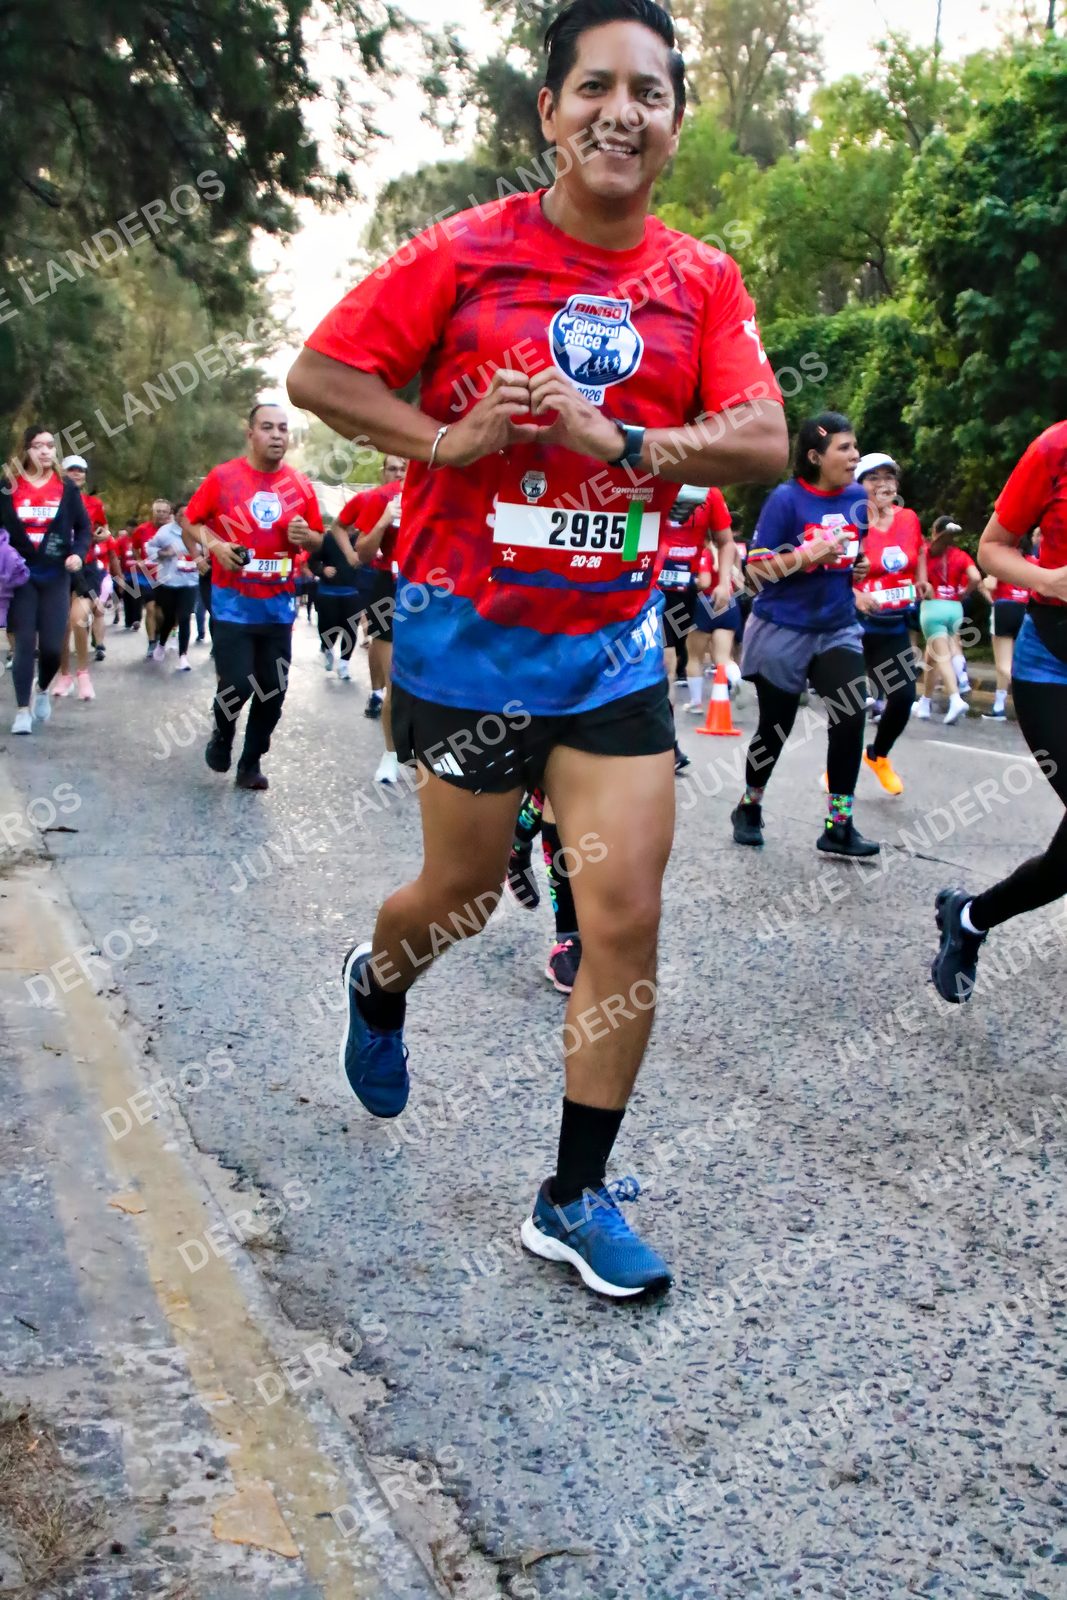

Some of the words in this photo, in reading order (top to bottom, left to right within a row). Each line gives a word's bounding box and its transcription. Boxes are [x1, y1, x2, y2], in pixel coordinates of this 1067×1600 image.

[574, 303, 622, 319] BIMBO
[573, 318, 619, 338] Global
[564, 329, 602, 350] Race
[549, 511, 627, 549] 2935
[258, 560, 278, 571] 2311
[630, 571, 644, 583] 5K
